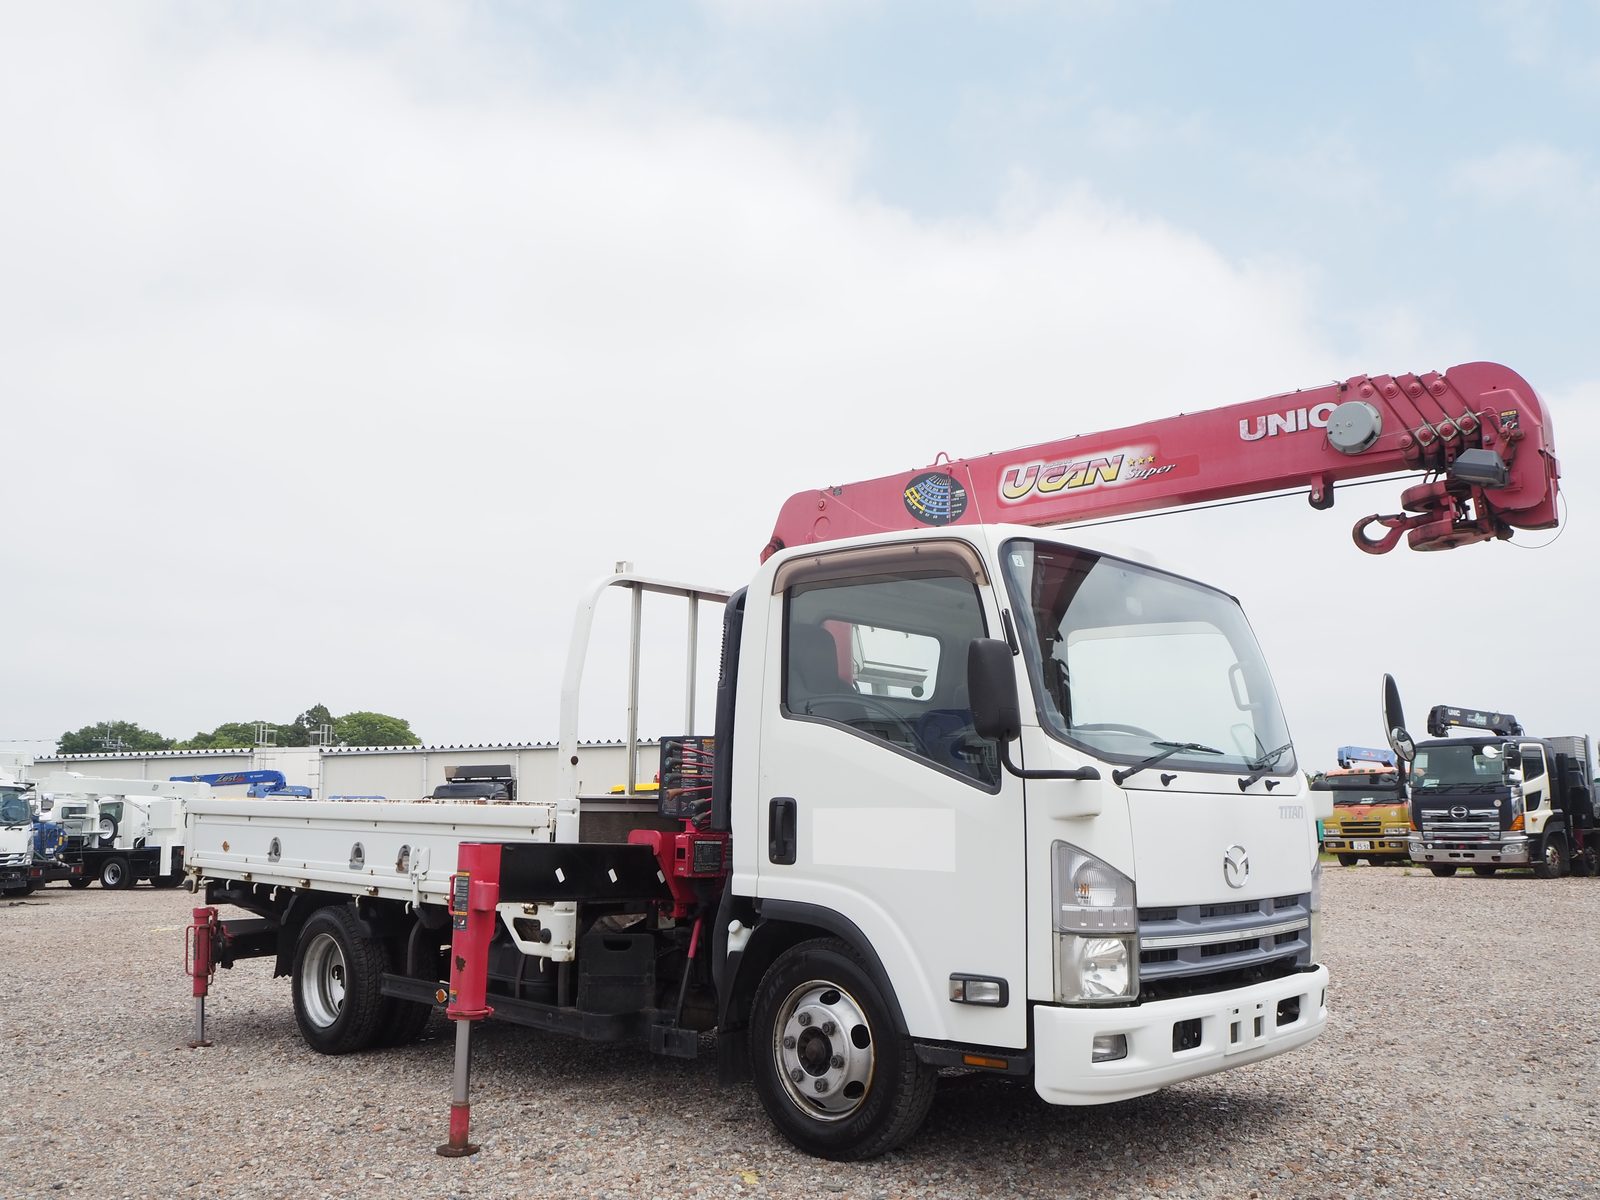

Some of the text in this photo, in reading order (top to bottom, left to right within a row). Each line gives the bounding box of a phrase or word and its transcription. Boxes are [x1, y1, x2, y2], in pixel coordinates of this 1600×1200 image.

[1002, 454, 1124, 500] UCAN
[1124, 464, 1177, 480] Super
[1279, 805, 1304, 819] TITAN
